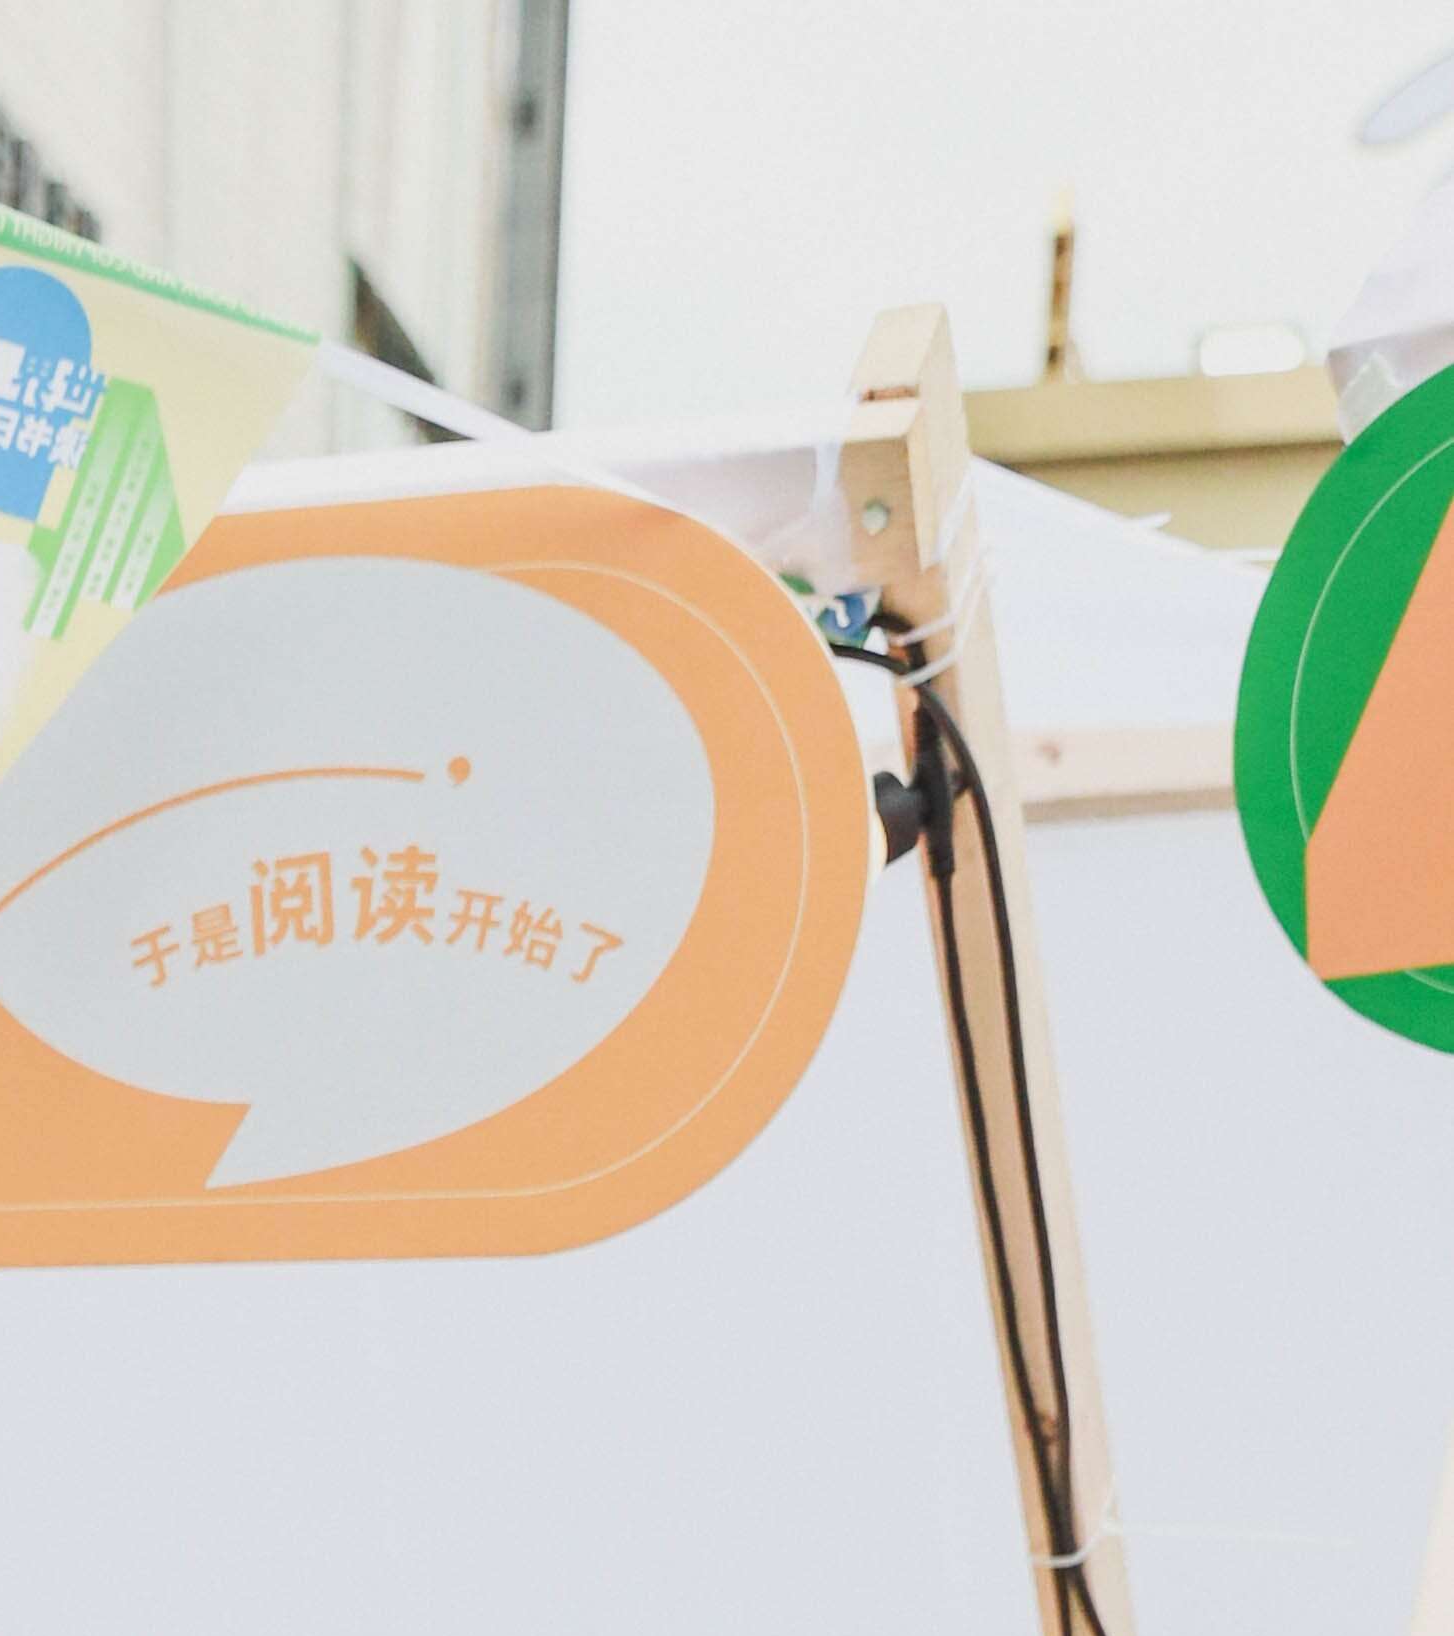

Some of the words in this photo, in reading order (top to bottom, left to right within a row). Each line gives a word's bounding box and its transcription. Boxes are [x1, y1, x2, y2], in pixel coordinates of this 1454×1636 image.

[129, 844, 627, 990] 于是阅读开始了
